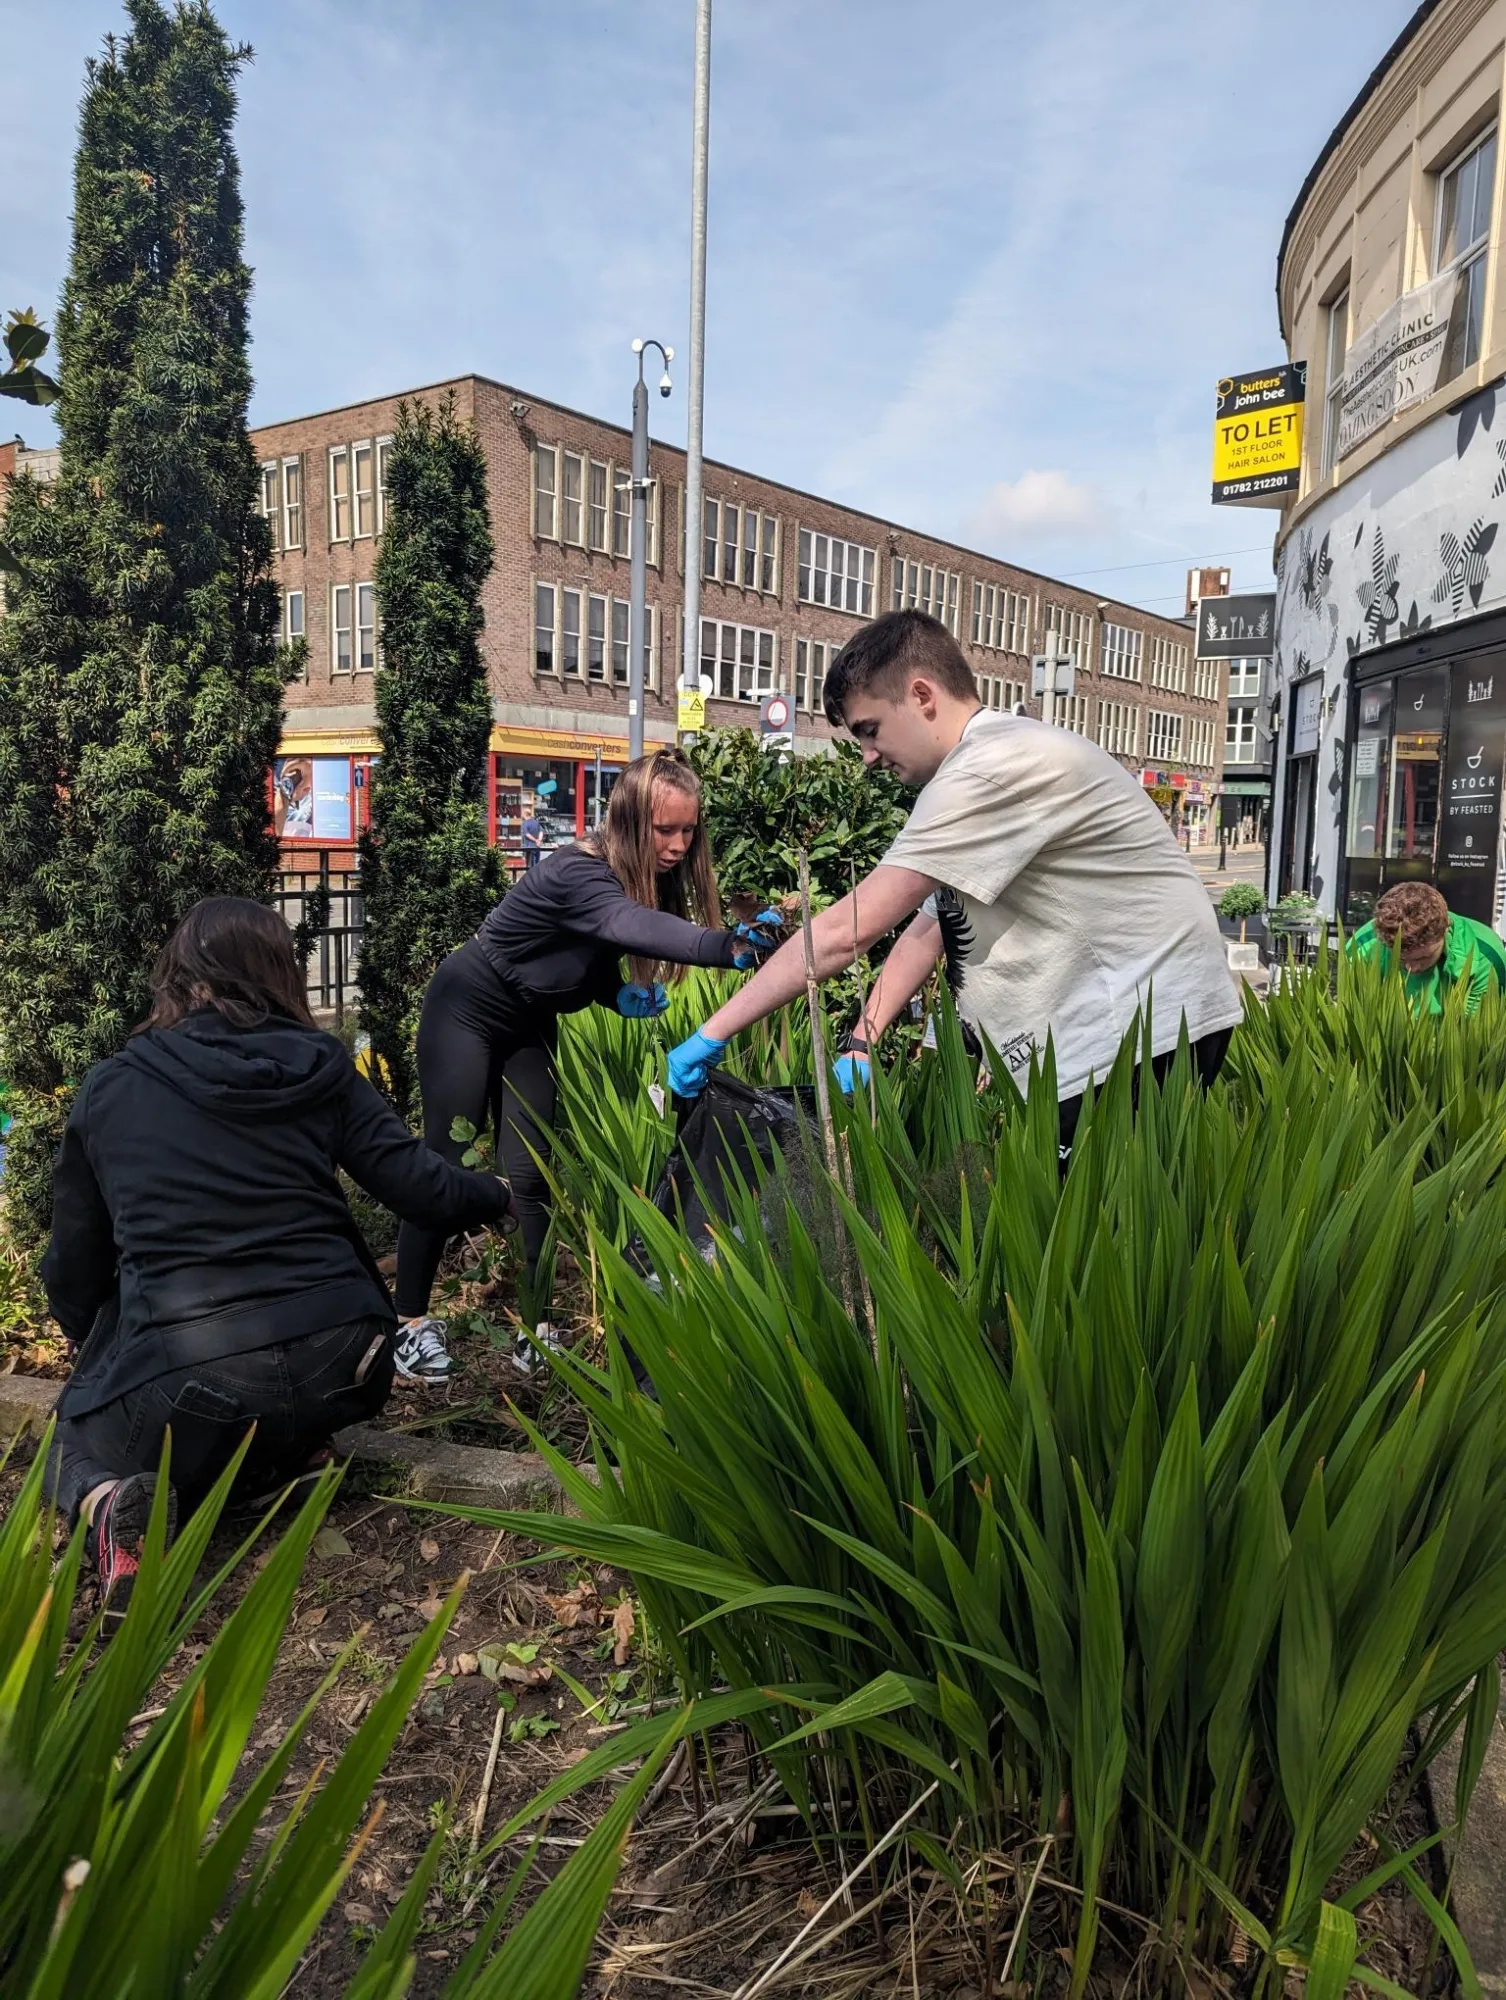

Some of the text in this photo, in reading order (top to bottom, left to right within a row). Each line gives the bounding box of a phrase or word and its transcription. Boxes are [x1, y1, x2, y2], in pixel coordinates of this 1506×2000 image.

[1349, 341, 1389, 389] AESTHETIC
[1391, 313, 1434, 347] CLINIC
[1240, 377, 1281, 394] butters
[1234, 387, 1286, 410] john bee
[1375, 371, 1419, 419] SOON
[1221, 412, 1297, 445] TO LET
[1232, 439, 1283, 456] 1ST FLOOR
[1228, 452, 1286, 470] HAIR SALON
[1222, 475, 1288, 496] 01782 212201
[547, 737, 622, 753] cashconverters
[1451, 775, 1495, 790] STOCK
[1449, 804, 1494, 816] BY FEASTED
